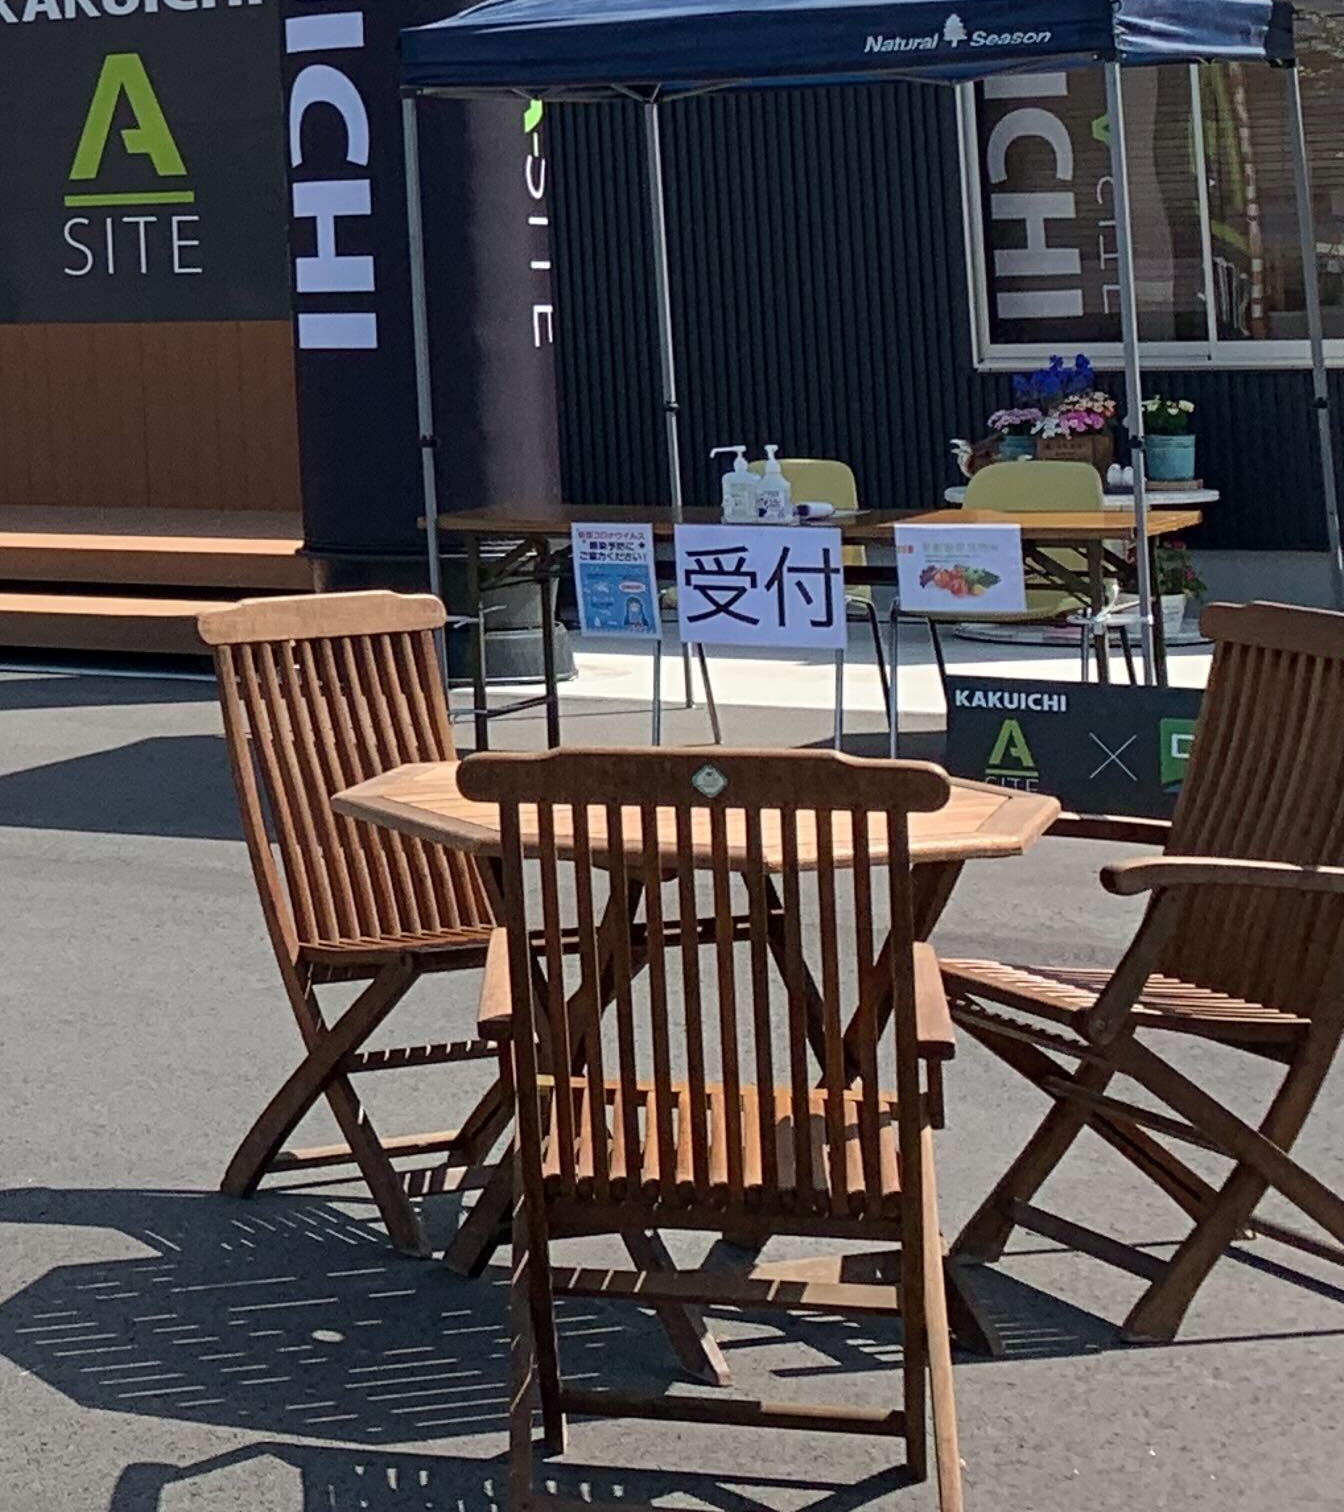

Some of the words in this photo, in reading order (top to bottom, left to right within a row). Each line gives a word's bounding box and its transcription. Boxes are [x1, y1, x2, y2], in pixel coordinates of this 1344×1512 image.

[864, 33, 939, 53] Natural
[970, 31, 1052, 47] Season
[68, 52, 189, 180] A
[63, 215, 203, 276] SITE
[684, 545, 841, 628] 受付
[955, 689, 1067, 712] KAKUICHI
[988, 718, 1036, 768] A
